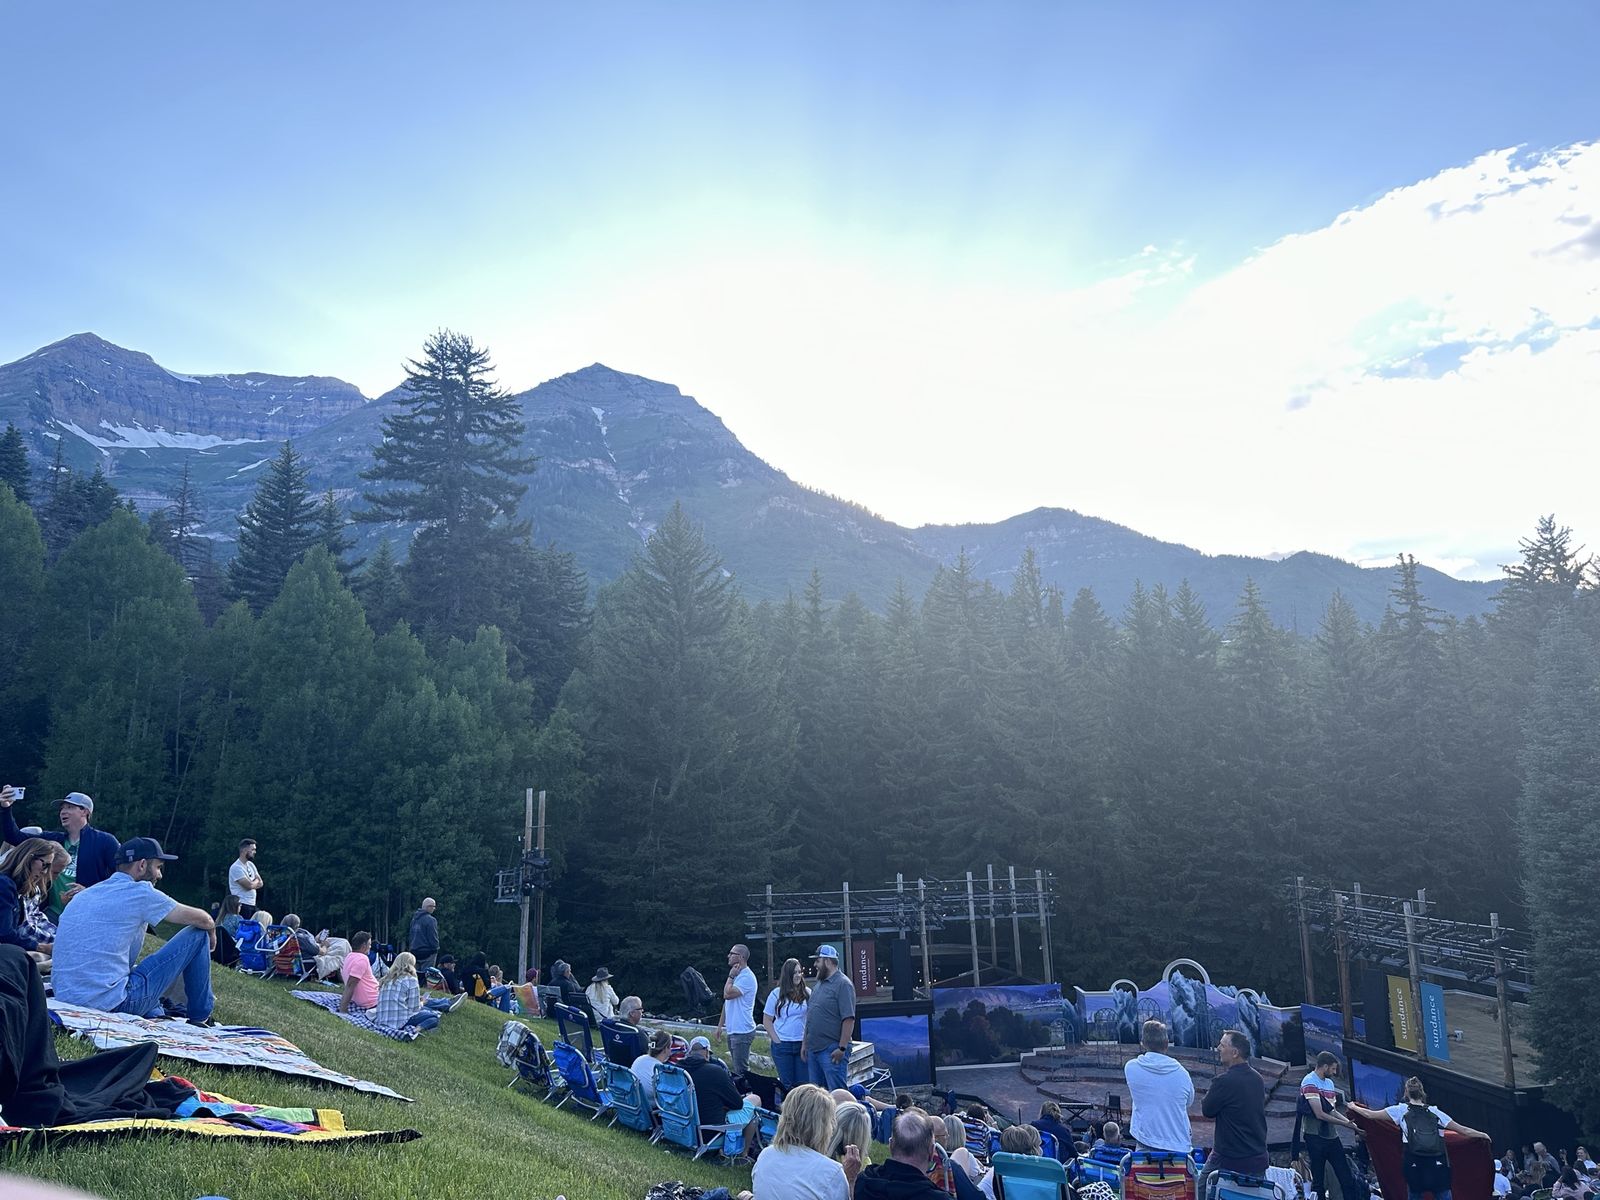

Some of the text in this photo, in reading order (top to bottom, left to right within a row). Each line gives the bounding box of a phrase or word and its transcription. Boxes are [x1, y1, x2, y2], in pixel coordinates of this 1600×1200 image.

[859, 949, 867, 990] sundance
[1397, 988, 1408, 1040] sundance
[1429, 995, 1439, 1048] sundance
